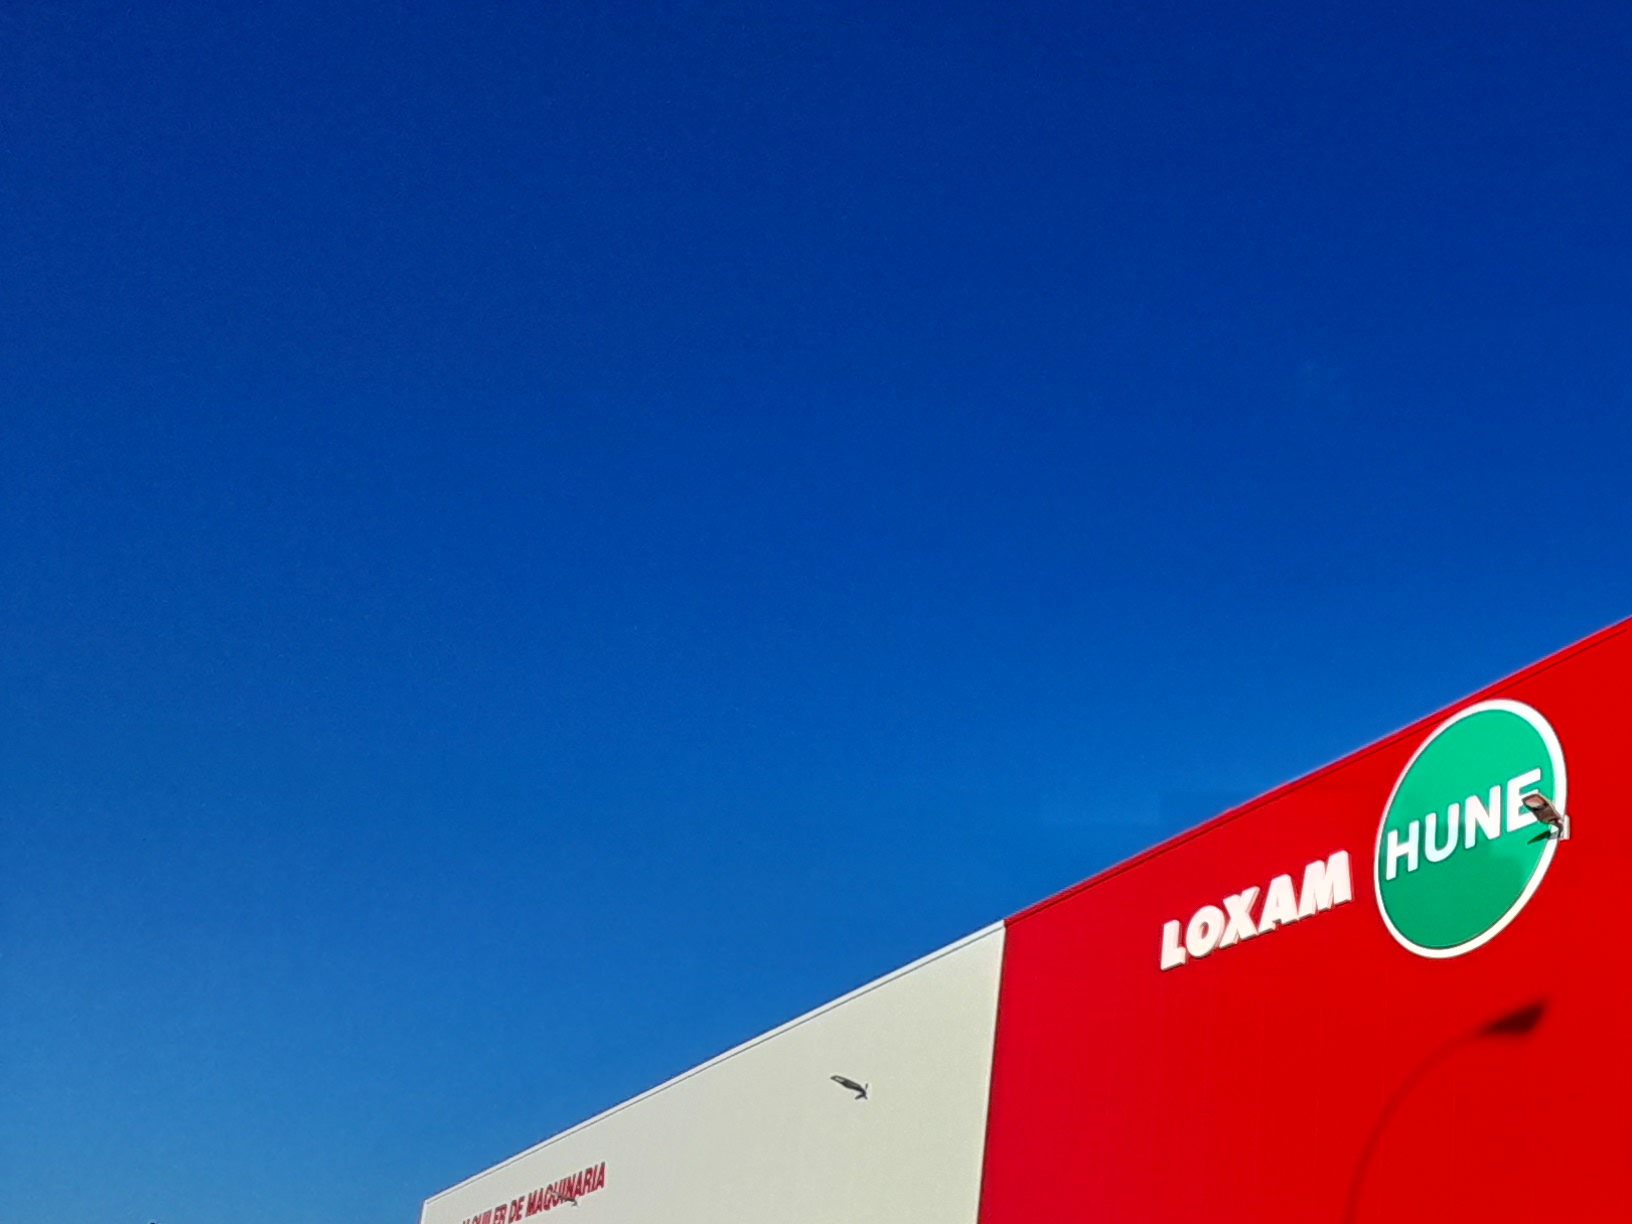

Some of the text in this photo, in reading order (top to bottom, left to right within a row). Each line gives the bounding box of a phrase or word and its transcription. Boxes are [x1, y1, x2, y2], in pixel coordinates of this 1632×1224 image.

[1160, 767, 1543, 971] LOXAM HUNE
[508, 1195, 525, 1224] DE
[525, 1161, 605, 1217] MAQUINARIA
